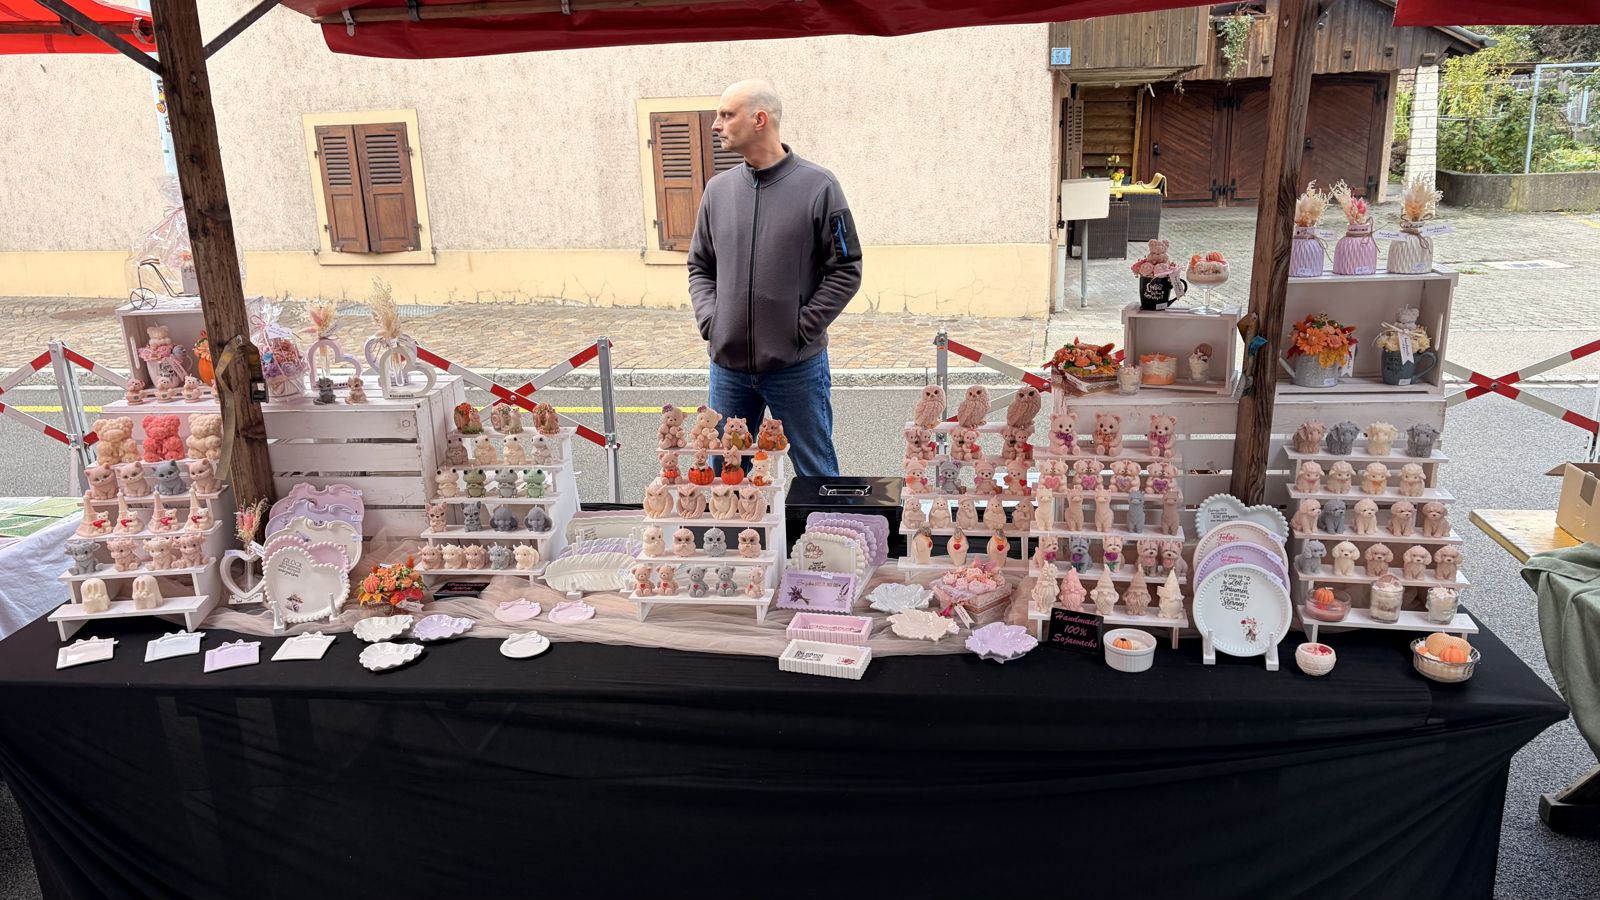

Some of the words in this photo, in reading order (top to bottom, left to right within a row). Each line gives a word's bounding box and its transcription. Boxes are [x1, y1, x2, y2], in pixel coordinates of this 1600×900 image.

[1055, 611, 1100, 626] Handmade
[1064, 625, 1087, 636] 100%
[1052, 633, 1097, 648] Sojawachs
